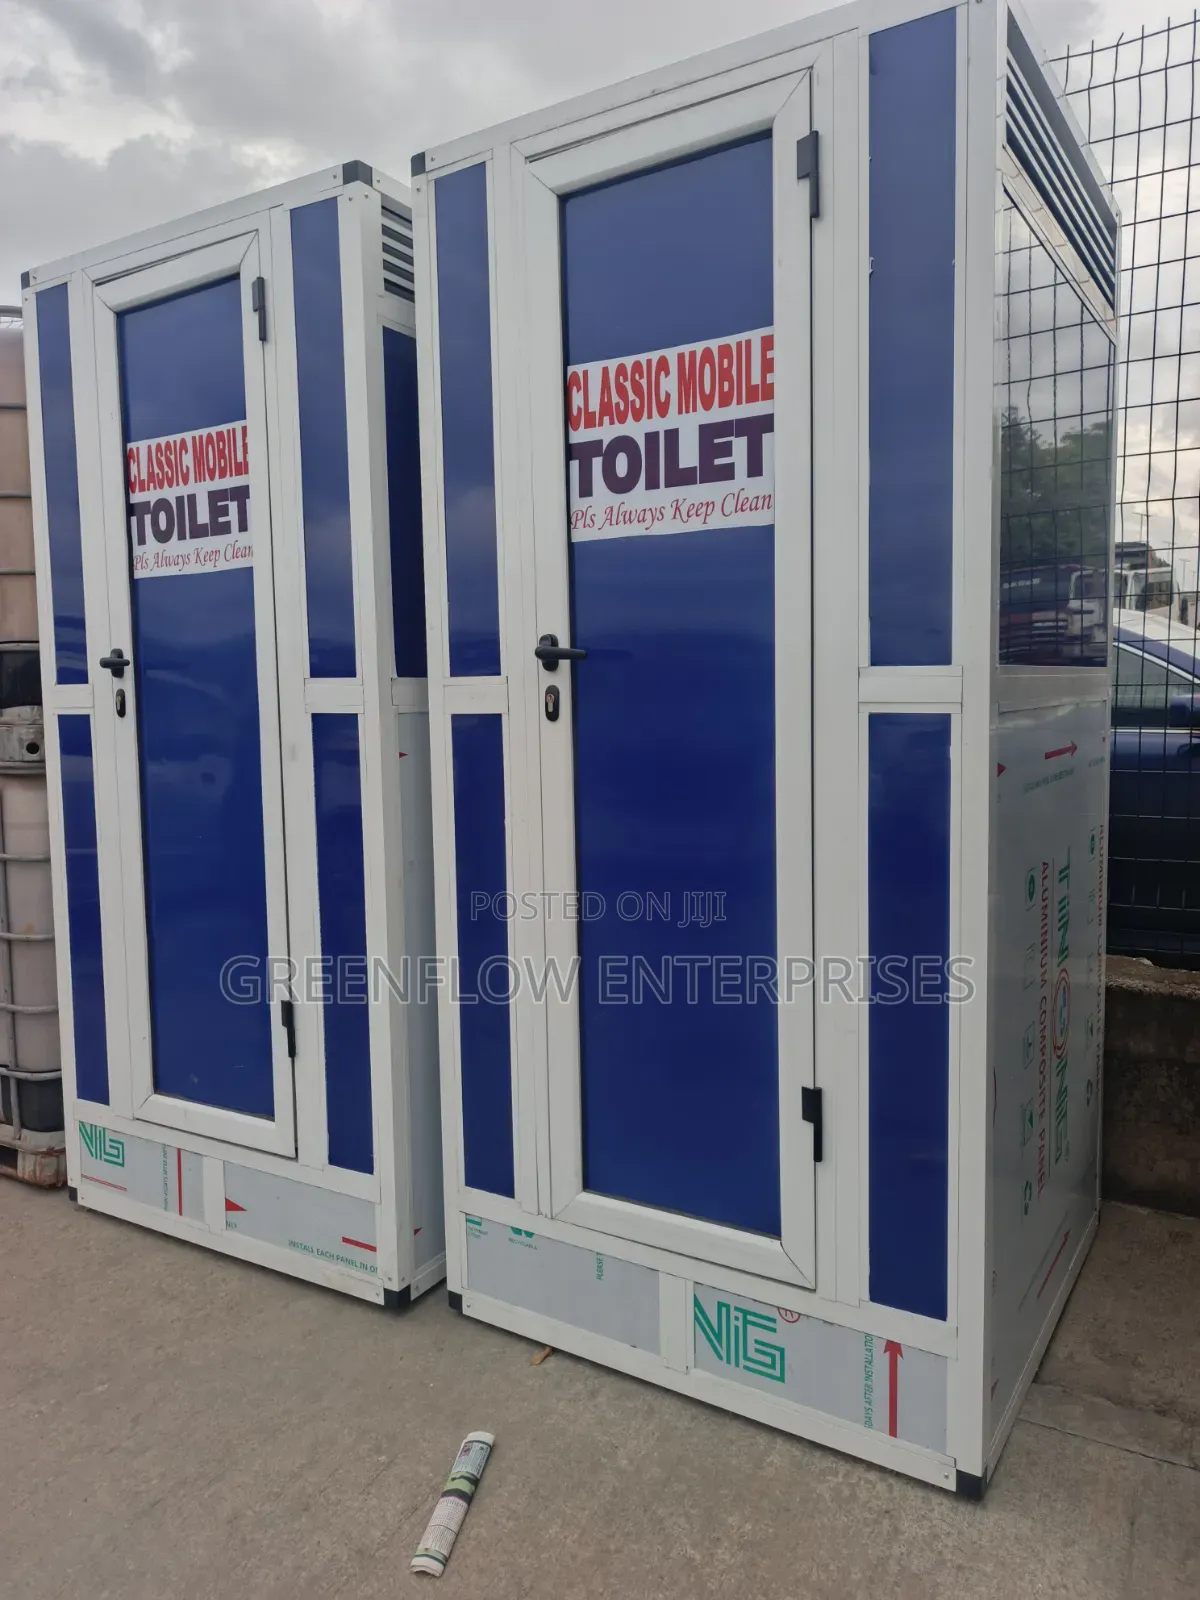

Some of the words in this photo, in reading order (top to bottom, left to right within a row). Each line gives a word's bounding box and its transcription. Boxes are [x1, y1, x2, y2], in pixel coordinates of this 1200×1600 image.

[567, 354, 671, 431] CLASSIC
[677, 334, 774, 415] MOBILE
[127, 437, 190, 494] CLASSIC
[570, 412, 774, 498] TOILET
[129, 484, 250, 546] TOILET
[571, 505, 596, 530] Pls
[598, 501, 665, 530] Always
[670, 497, 715, 524] Keep
[721, 488, 773, 517] Clean
[133, 551, 149, 571] Pls
[150, 549, 191, 571] Always
[193, 547, 221, 567] Keep
[1040, 861, 1049, 990] ALUMINIUM
[1038, 996, 1047, 1121] COMPOSITE
[1037, 1127, 1045, 1196] PANEL
[288, 1239, 315, 1254] INSTALL
[316, 1248, 335, 1261] EACH
[336, 1254, 359, 1268] PANEL
[359, 1261, 368, 1271] IN
[864, 1335, 874, 1383] INSTALLATIO
[864, 1382, 873, 1406] AFTER
